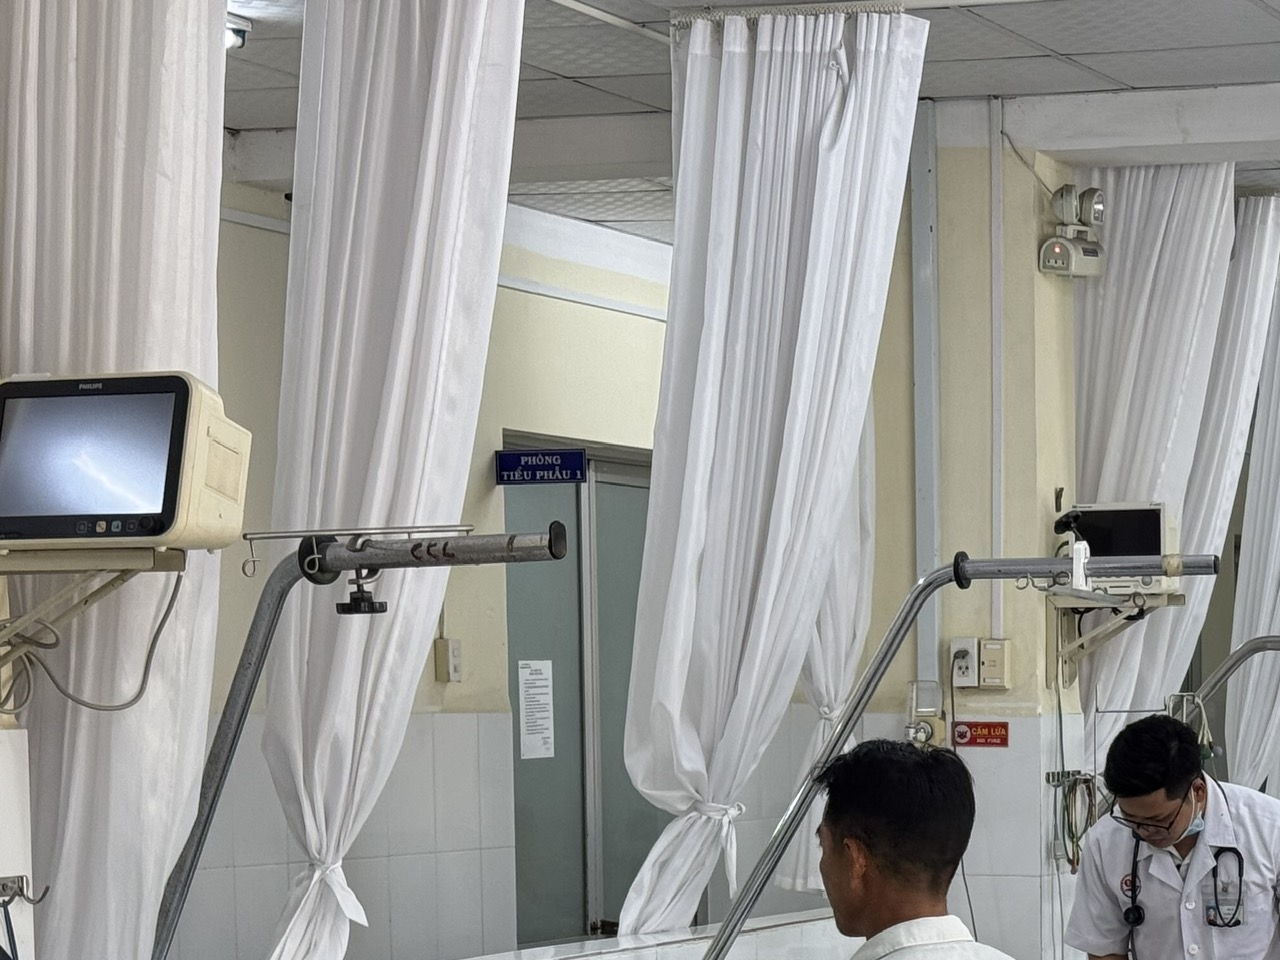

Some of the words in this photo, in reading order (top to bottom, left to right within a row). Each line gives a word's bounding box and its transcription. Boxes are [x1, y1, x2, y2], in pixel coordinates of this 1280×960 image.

[520, 454, 561, 465] PHÒNG
[501, 466, 532, 480] TIỂU
[575, 470, 582, 479] 1
